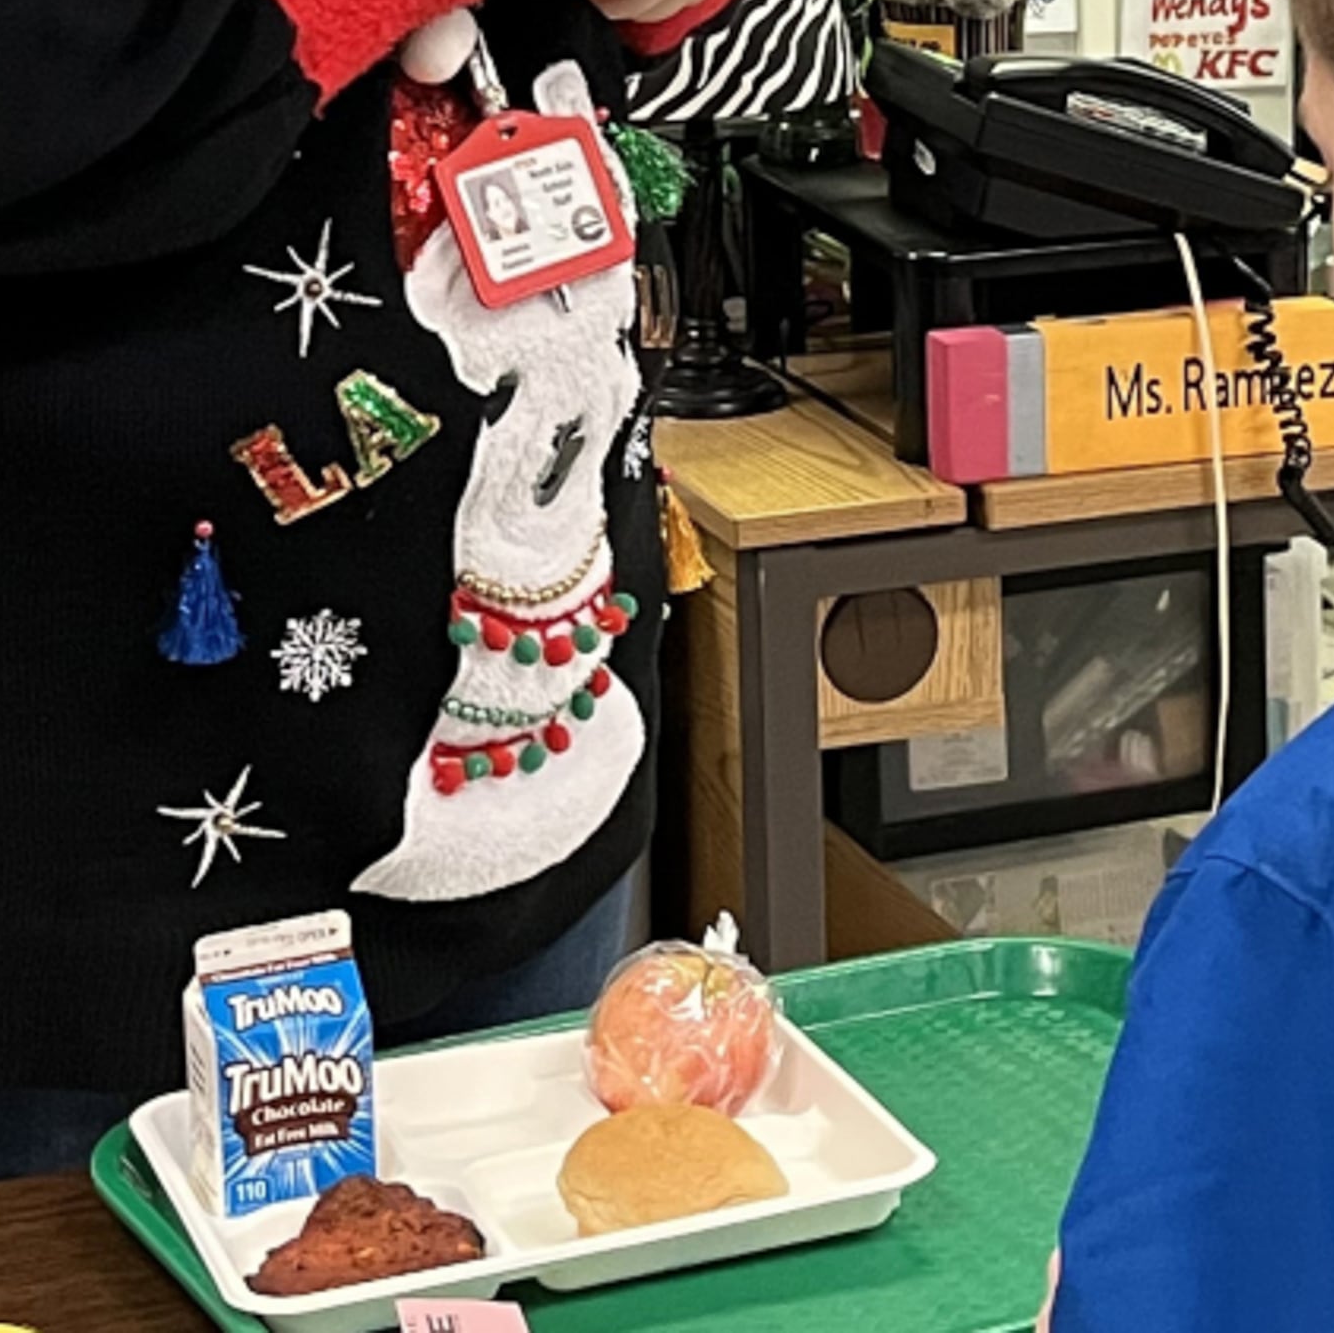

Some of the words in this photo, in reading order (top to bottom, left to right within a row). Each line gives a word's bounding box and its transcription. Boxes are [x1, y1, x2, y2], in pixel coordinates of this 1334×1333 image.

[1193, 49, 1280, 80] KFC
[1105, 362, 1173, 421] Ms.
[229, 985, 343, 1031] TruMoo
[225, 1052, 364, 1115] TruMoo
[250, 1096, 346, 1127] Chocolate
[235, 1179, 267, 1203] 110
